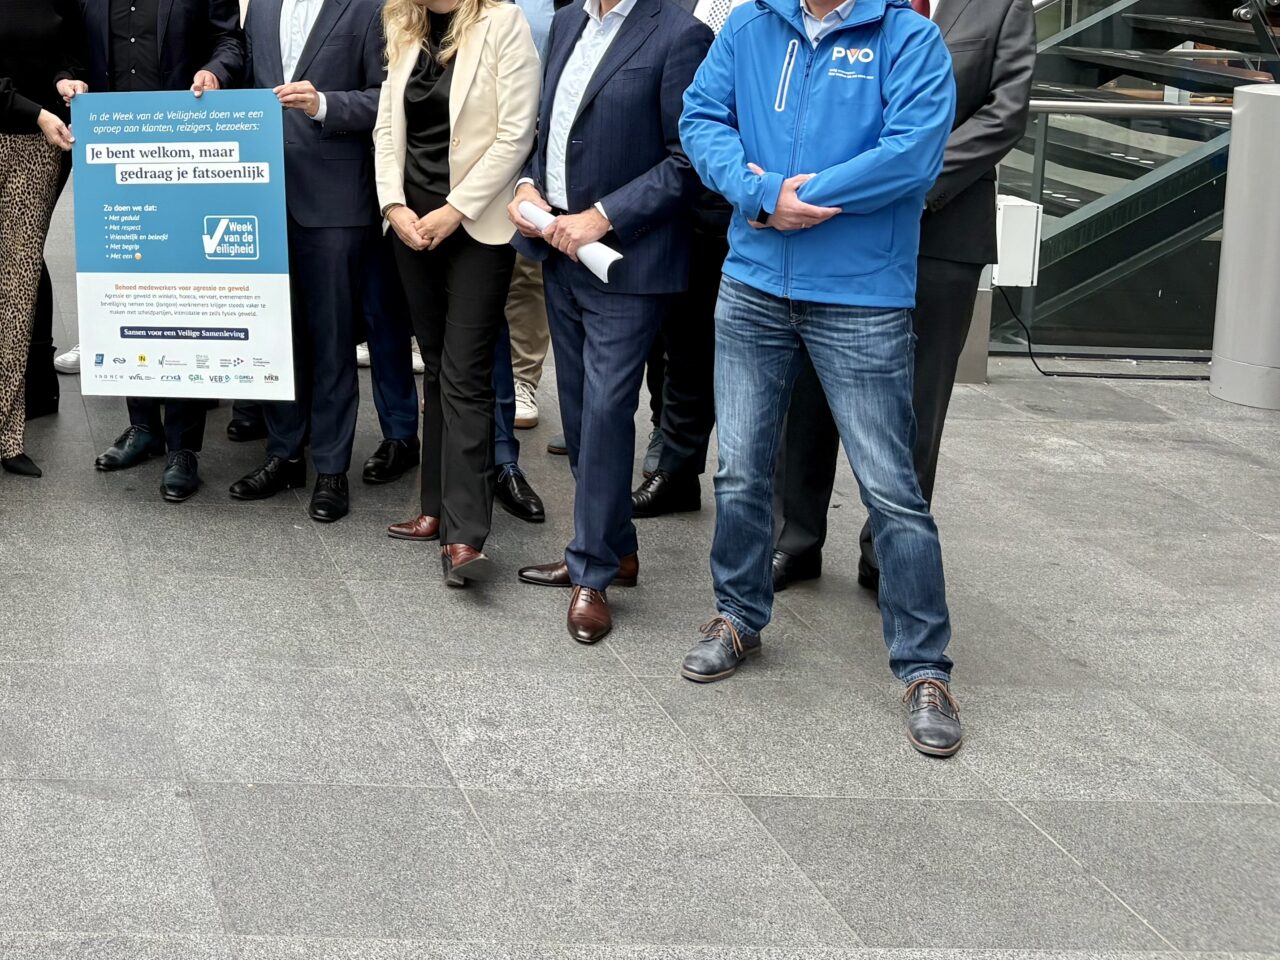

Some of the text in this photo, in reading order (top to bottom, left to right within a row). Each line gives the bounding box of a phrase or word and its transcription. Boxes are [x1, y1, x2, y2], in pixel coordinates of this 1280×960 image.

[832, 47, 874, 65] PVO
[89, 110, 264, 122] In de Week van de Veiligheid doen we een
[93, 122, 259, 134] oproep aan klanten, reizigers, bezoekers:
[91, 146, 235, 160] Je bent welkom, maar
[120, 166, 265, 182] gedraag je fatsoenlijk
[103, 204, 112, 212] Zo
[114, 204, 131, 212] doen
[144, 204, 158, 212] dat:
[228, 221, 253, 232] Week
[223, 232, 254, 243] van de
[124, 328, 146, 336] Samen
[177, 329, 200, 337] Veilige
[201, 330, 245, 338] Samenleving
